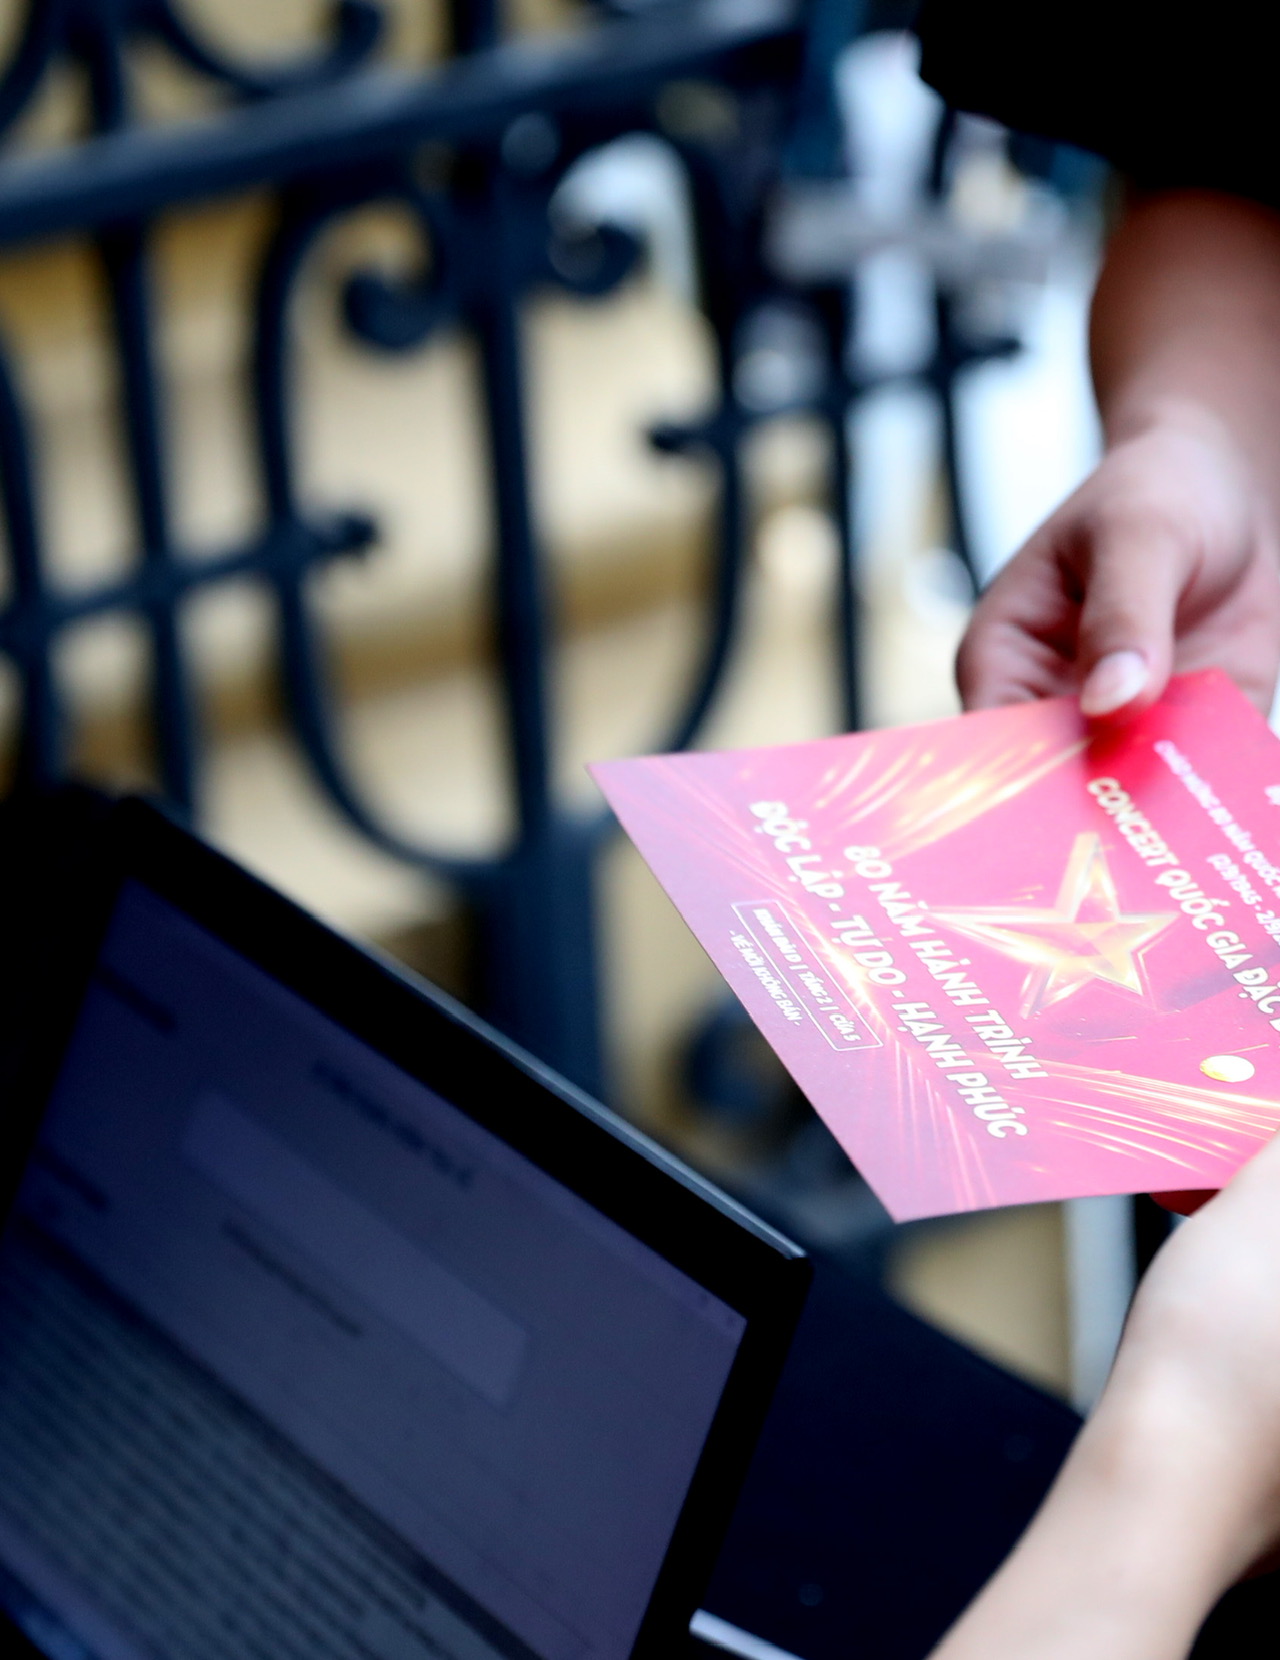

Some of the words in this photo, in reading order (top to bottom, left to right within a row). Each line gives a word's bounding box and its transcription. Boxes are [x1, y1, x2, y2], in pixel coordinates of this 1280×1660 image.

[749, 800, 812, 854] ĐỘC
[785, 853, 845, 899] LẬP
[843, 845, 893, 879] 80
[1087, 777, 1181, 868] CONCERT
[1154, 868, 1231, 931] QUỐC
[1205, 930, 1254, 970] GIA
[829, 914, 884, 948] TỰ
[867, 881, 936, 937] NĂM
[738, 947, 765, 967] MỜI
[851, 950, 907, 986] DO
[908, 939, 991, 1007] HÀNH
[751, 966, 788, 1000] KHÔNG
[815, 996, 834, 1005] 2
[842, 1033, 862, 1042] 5
[891, 1001, 973, 1069] HẠNH
[964, 1009, 1050, 1080] TRÌNH
[945, 1071, 1028, 1139] PHÚC
